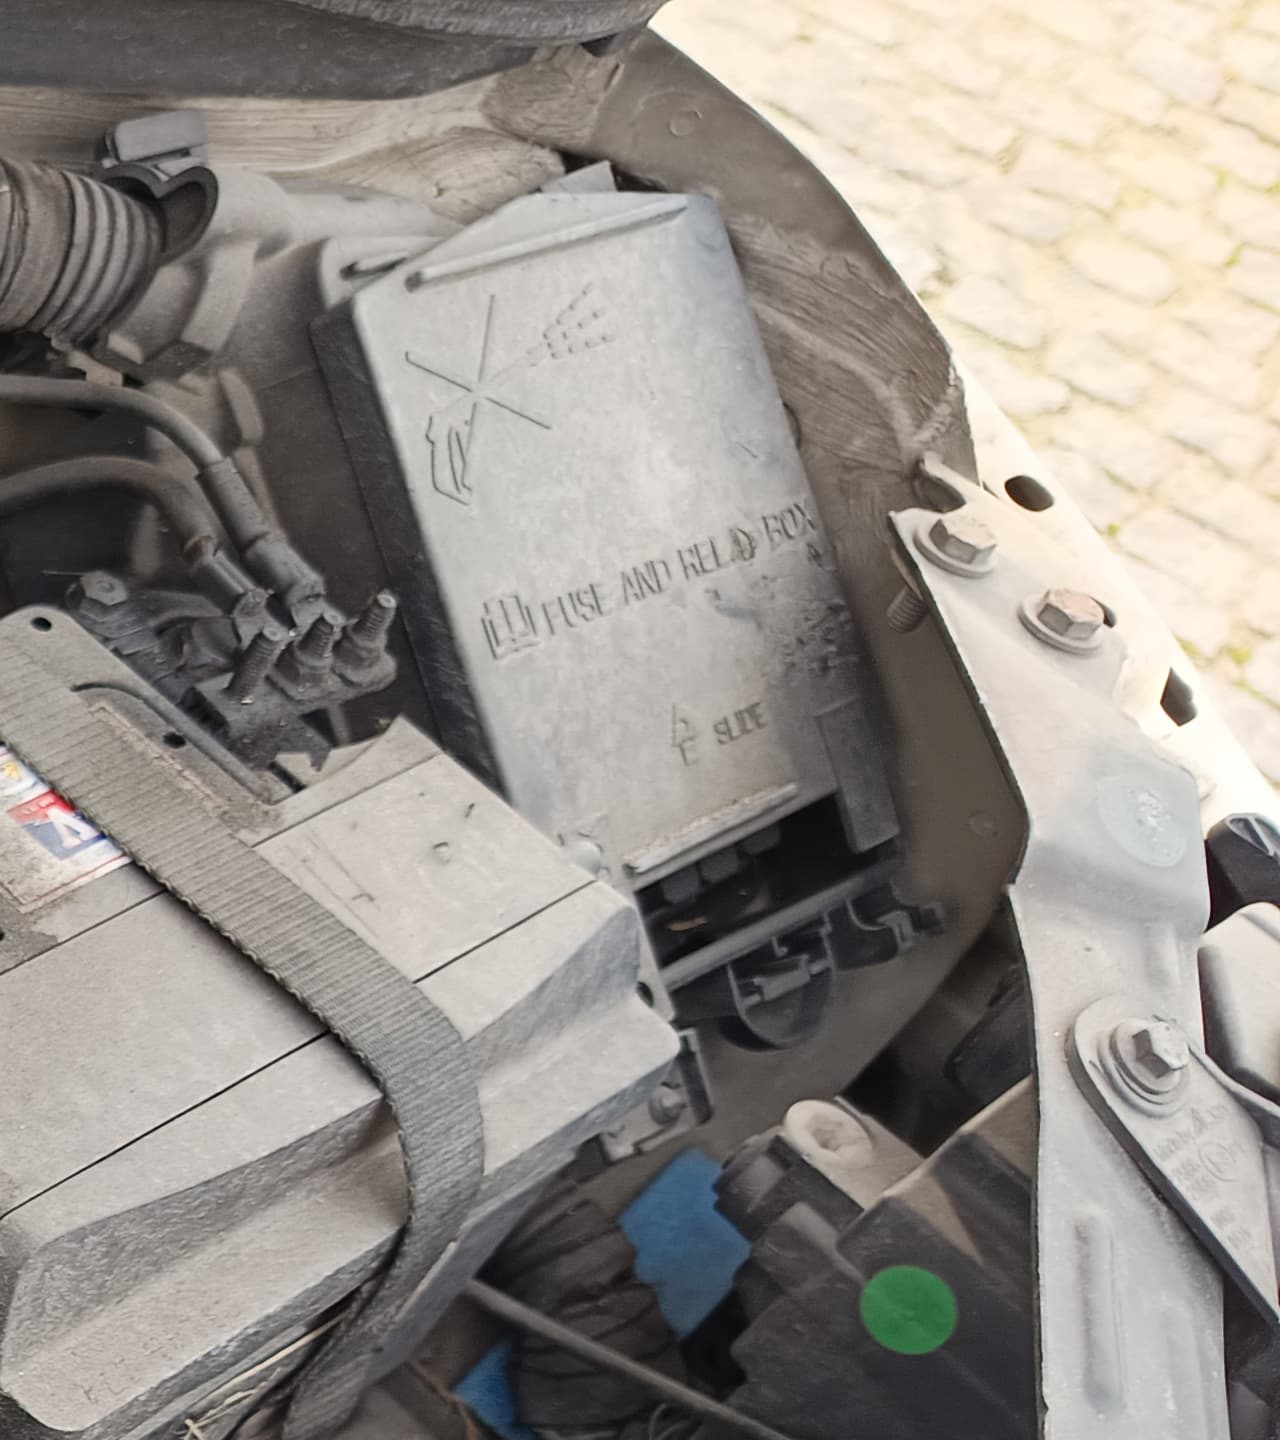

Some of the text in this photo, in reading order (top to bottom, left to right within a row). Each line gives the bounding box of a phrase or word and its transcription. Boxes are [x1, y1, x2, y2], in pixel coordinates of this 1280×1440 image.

[541, 583, 612, 636] FUSE
[621, 559, 672, 605] AND
[762, 502, 817, 548] BOX
[713, 702, 767, 745] SLIDE
